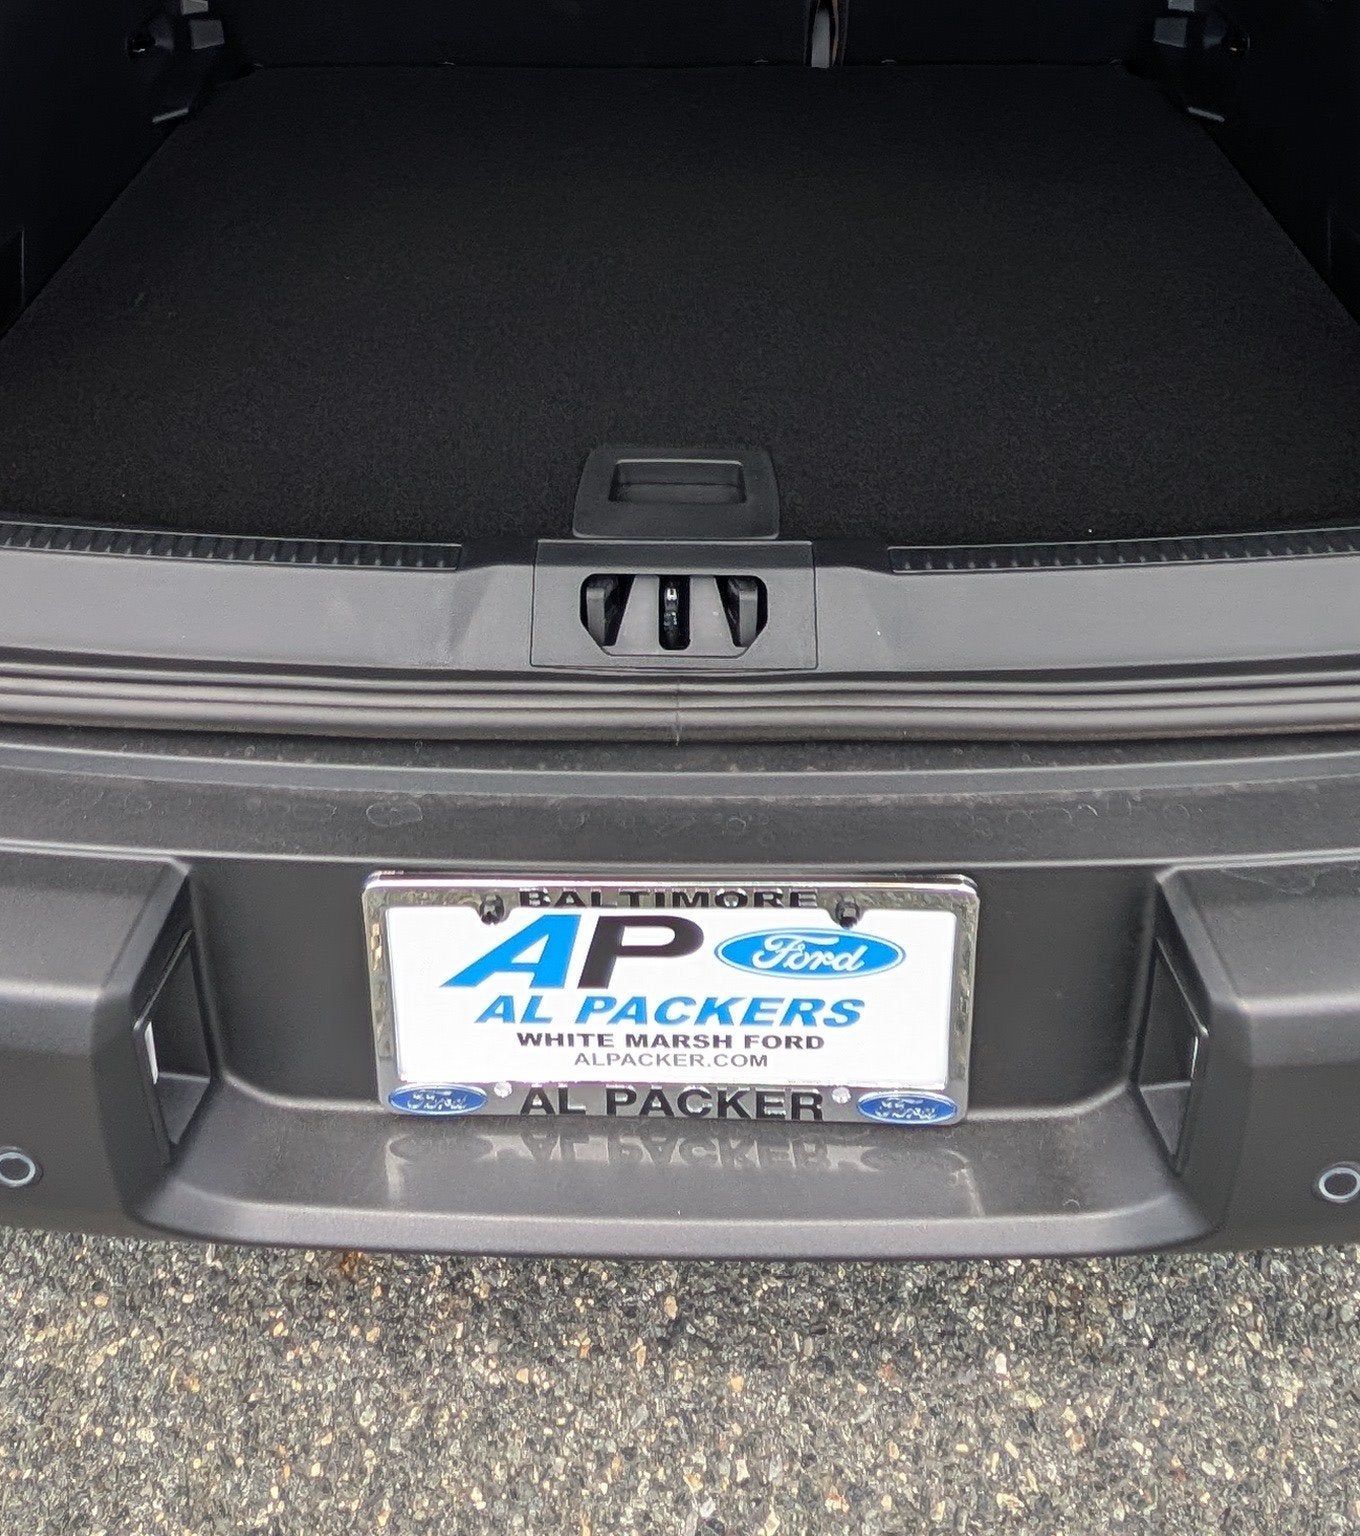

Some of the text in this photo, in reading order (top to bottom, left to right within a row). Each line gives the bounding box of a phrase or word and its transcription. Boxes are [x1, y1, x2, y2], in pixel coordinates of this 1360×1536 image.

[519, 887, 818, 909] BALTIMORE
[439, 914, 705, 990] AP
[751, 933, 868, 972] Ford
[474, 995, 866, 1028] AL PACKERS
[516, 1032, 826, 1050] WHITE MARSH FORD
[573, 1052, 769, 1068] ALPACKER.COM
[519, 1082, 824, 1122] AL PACKER
